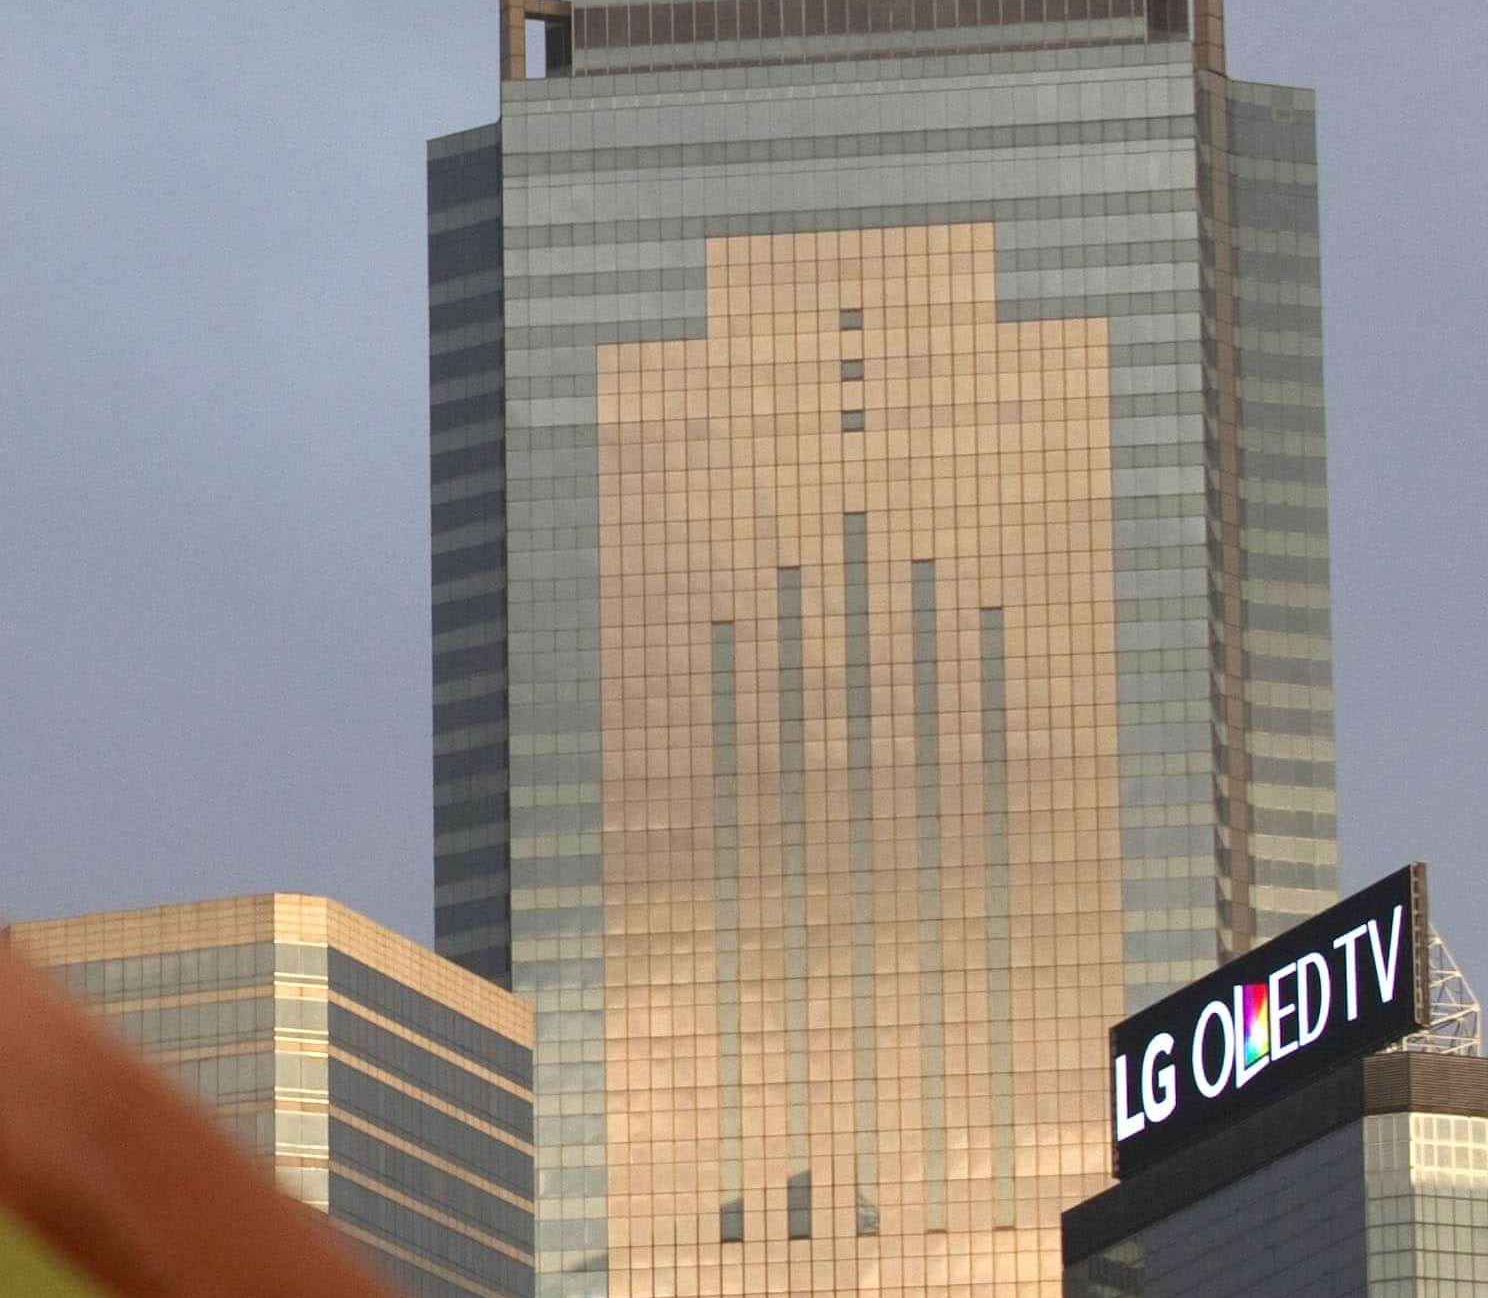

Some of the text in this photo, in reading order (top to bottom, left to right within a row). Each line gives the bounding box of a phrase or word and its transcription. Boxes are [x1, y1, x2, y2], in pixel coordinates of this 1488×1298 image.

[1115, 904, 1403, 1141] LG OLED TV
